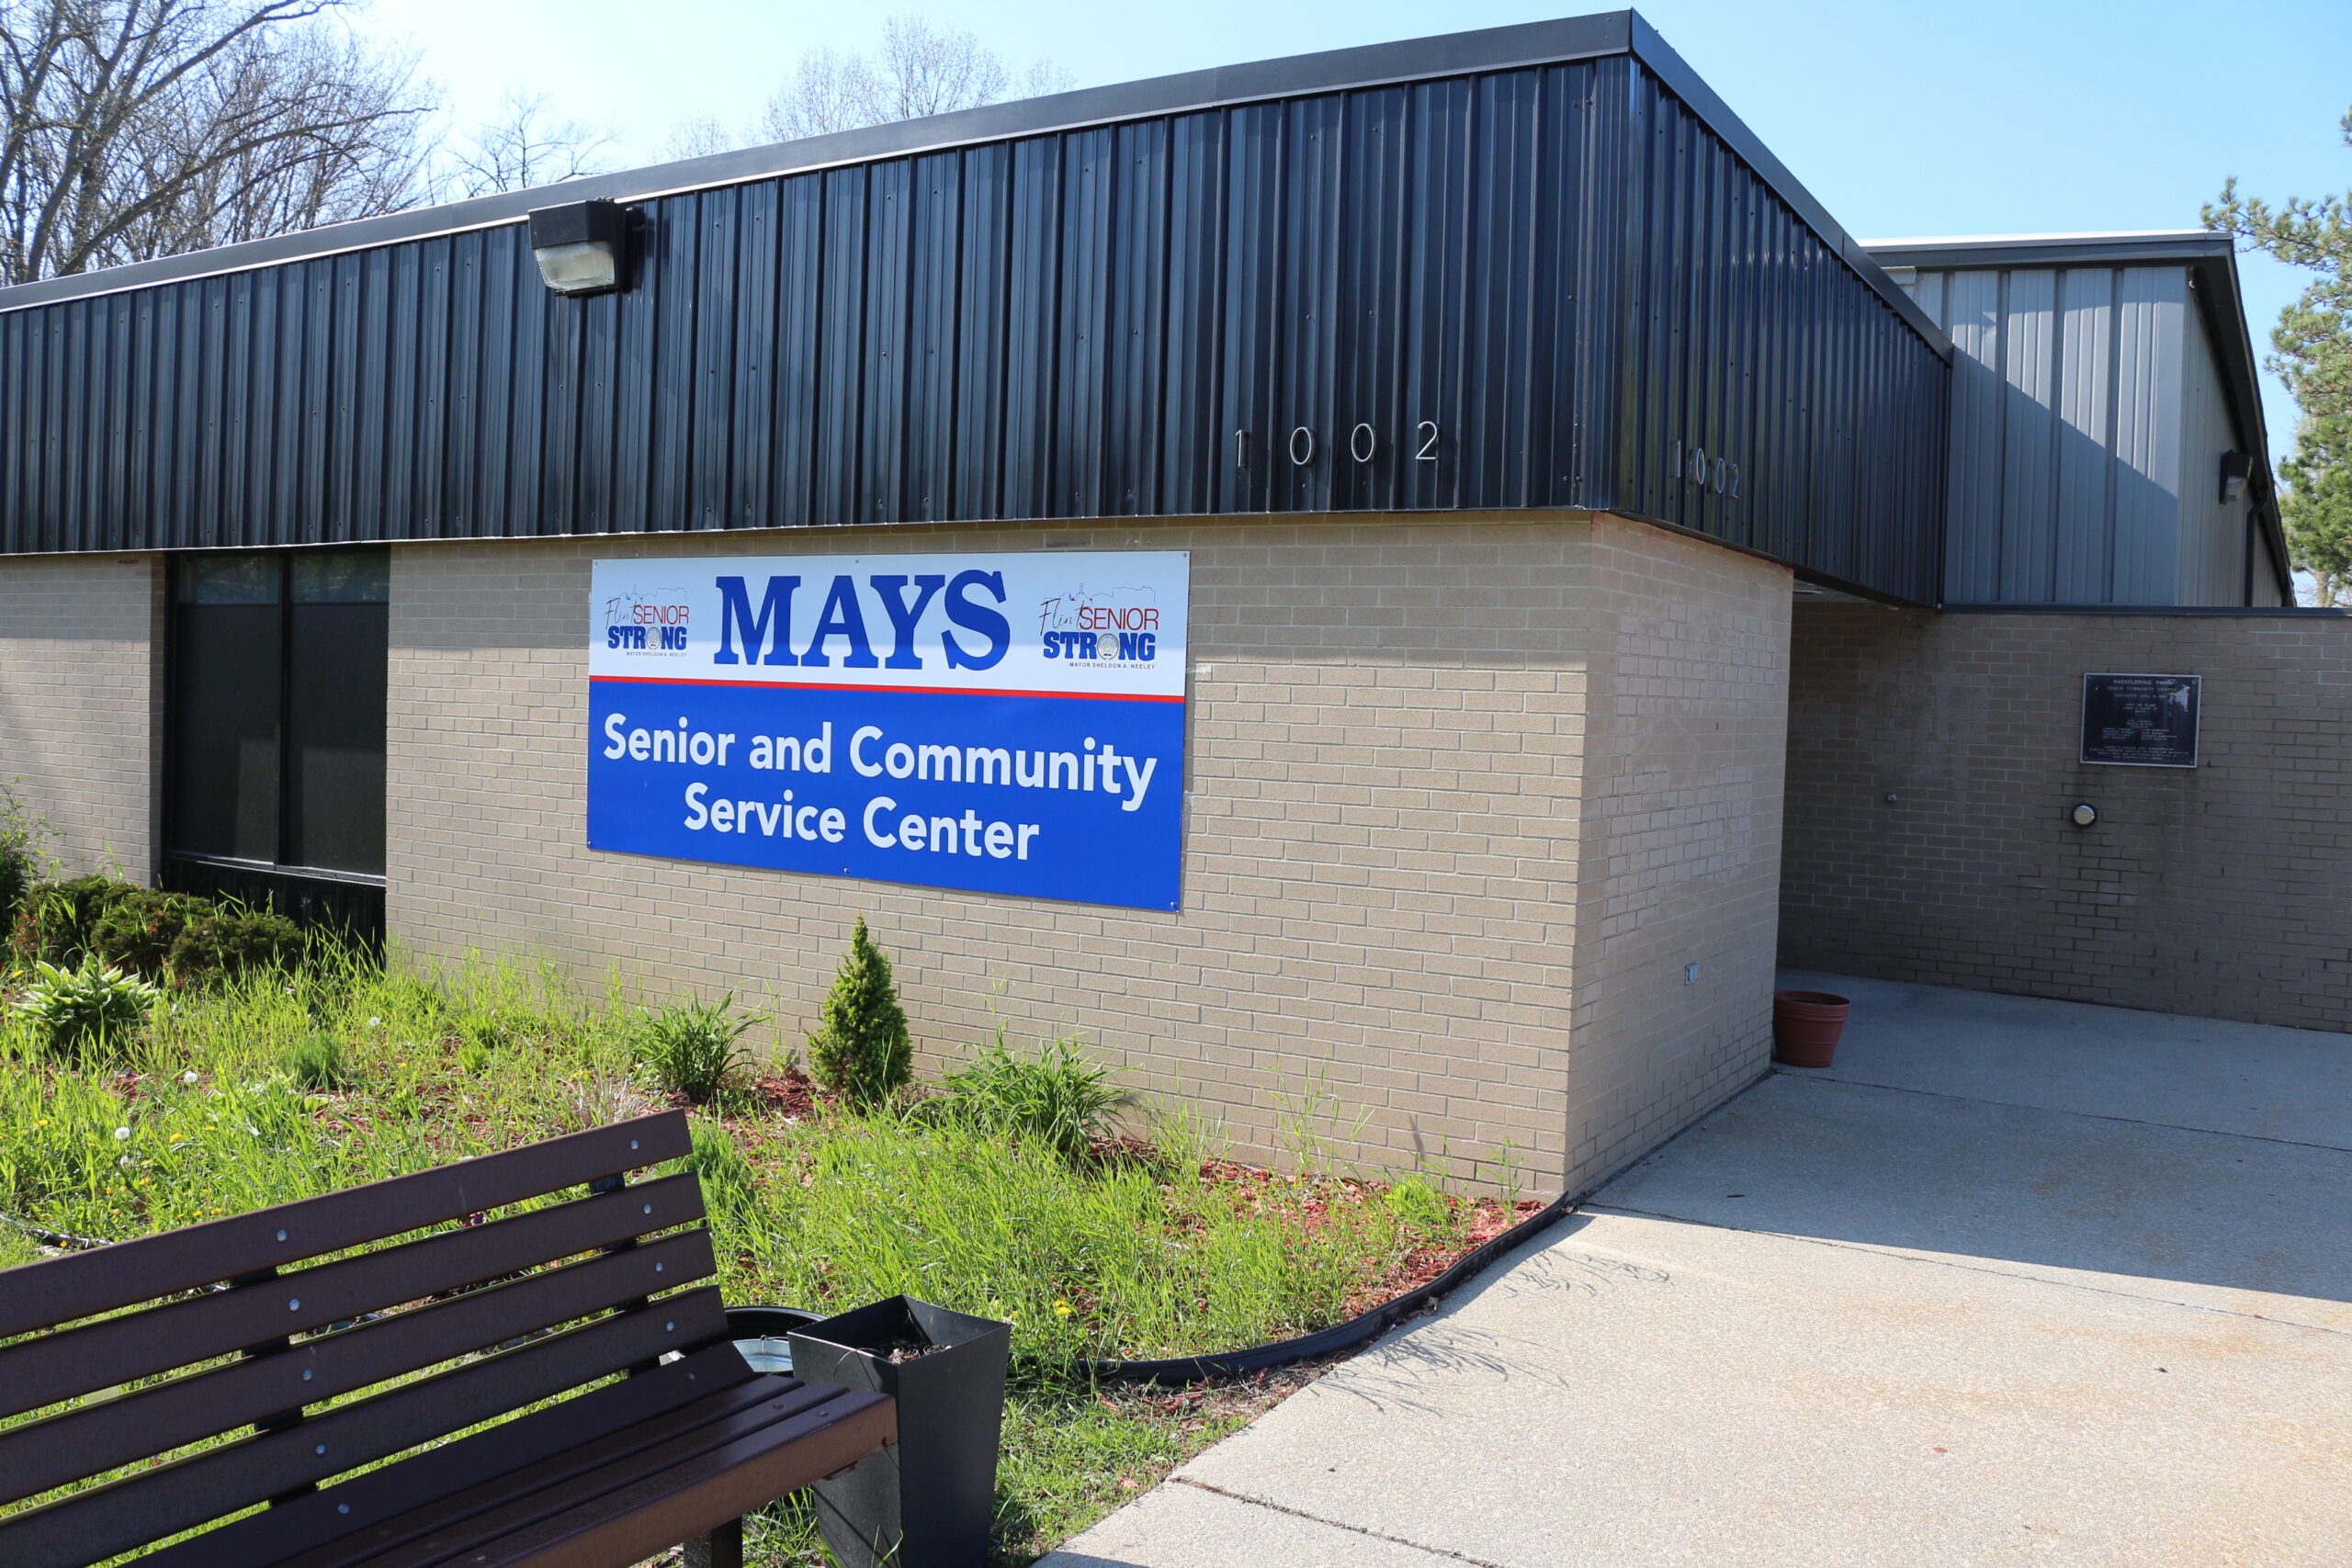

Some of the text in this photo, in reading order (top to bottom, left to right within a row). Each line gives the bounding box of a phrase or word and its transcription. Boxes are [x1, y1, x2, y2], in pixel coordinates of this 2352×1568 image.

[605, 597, 690, 630] Flint SENIOR
[714, 570, 1011, 671] MAYS
[1038, 598, 1159, 636] Flint SENIOR
[607, 626, 687, 650] STRONG
[1043, 631, 1156, 661] STRONG
[604, 713, 1158, 811] Senior and Community
[684, 783, 1040, 861] Service Center
